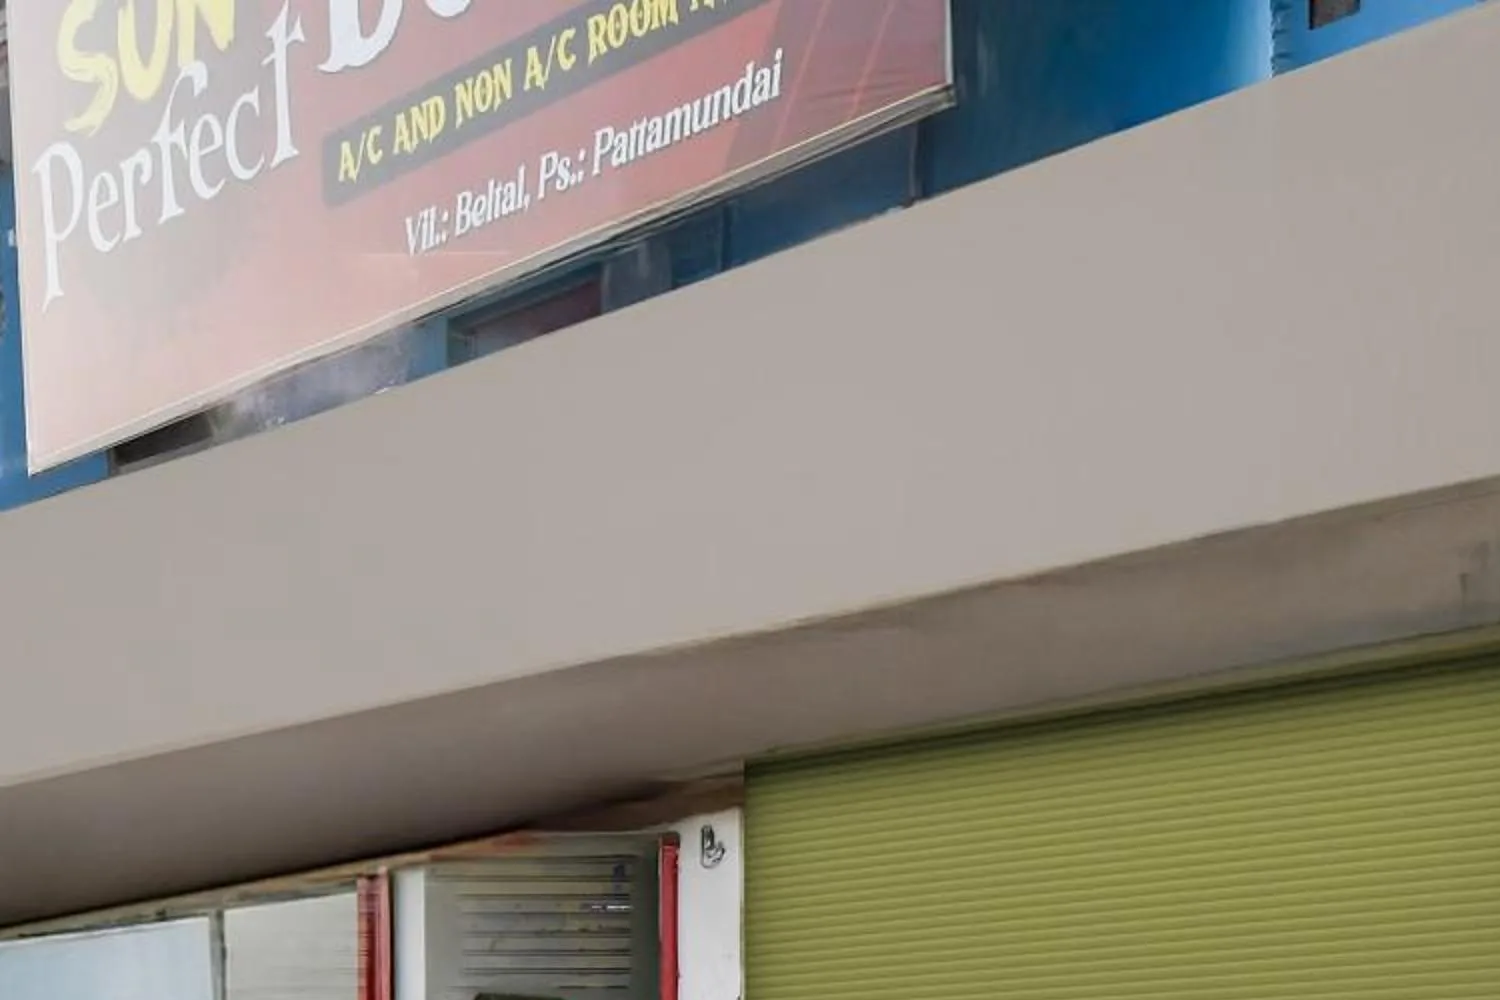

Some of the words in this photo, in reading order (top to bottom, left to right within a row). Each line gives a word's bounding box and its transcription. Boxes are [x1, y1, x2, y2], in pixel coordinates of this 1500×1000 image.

[31, 0, 305, 313] Perfect
[338, 125, 383, 184] A/C
[393, 95, 446, 155] AND
[455, 57, 513, 129] NON
[523, 27, 577, 91] A/C
[587, 0, 679, 67] ROOM
[455, 163, 531, 237] Beltal,
[592, 47, 783, 176] Pattamundai
